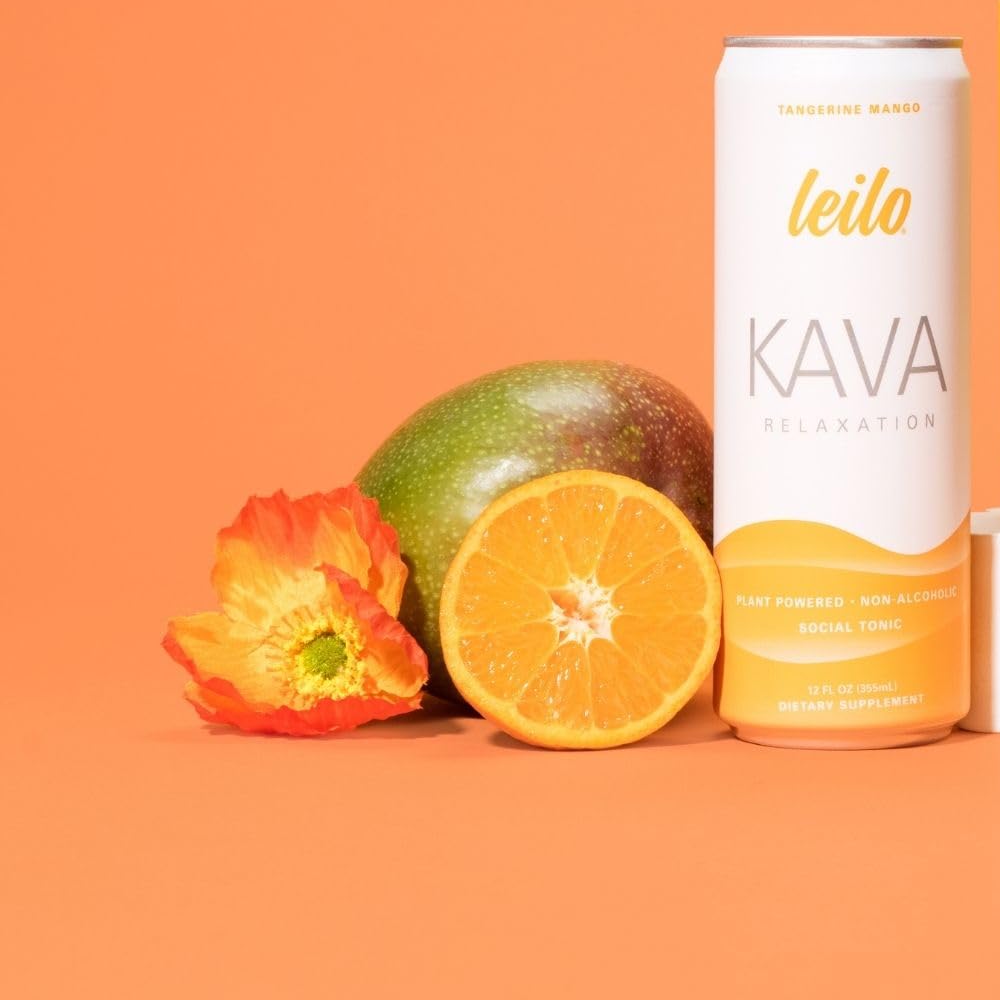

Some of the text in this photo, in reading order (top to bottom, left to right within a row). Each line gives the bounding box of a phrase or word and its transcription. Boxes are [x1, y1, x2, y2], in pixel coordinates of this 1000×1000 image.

[777, 102, 921, 116] TANGERINE MANGO
[787, 166, 911, 237] leilo
[749, 315, 948, 398] KAVA
[764, 413, 935, 433] RELAXATION
[736, 585, 958, 609] PLANT POWERED NON-ALCOHOLIC
[799, 618, 902, 634] SOCIAL TONIC
[808, 685, 819, 696] 12
[822, 684, 836, 695] FL
[838, 684, 854, 694] OZ
[778, 694, 926, 713] DIETARY SUPPLEMENT
